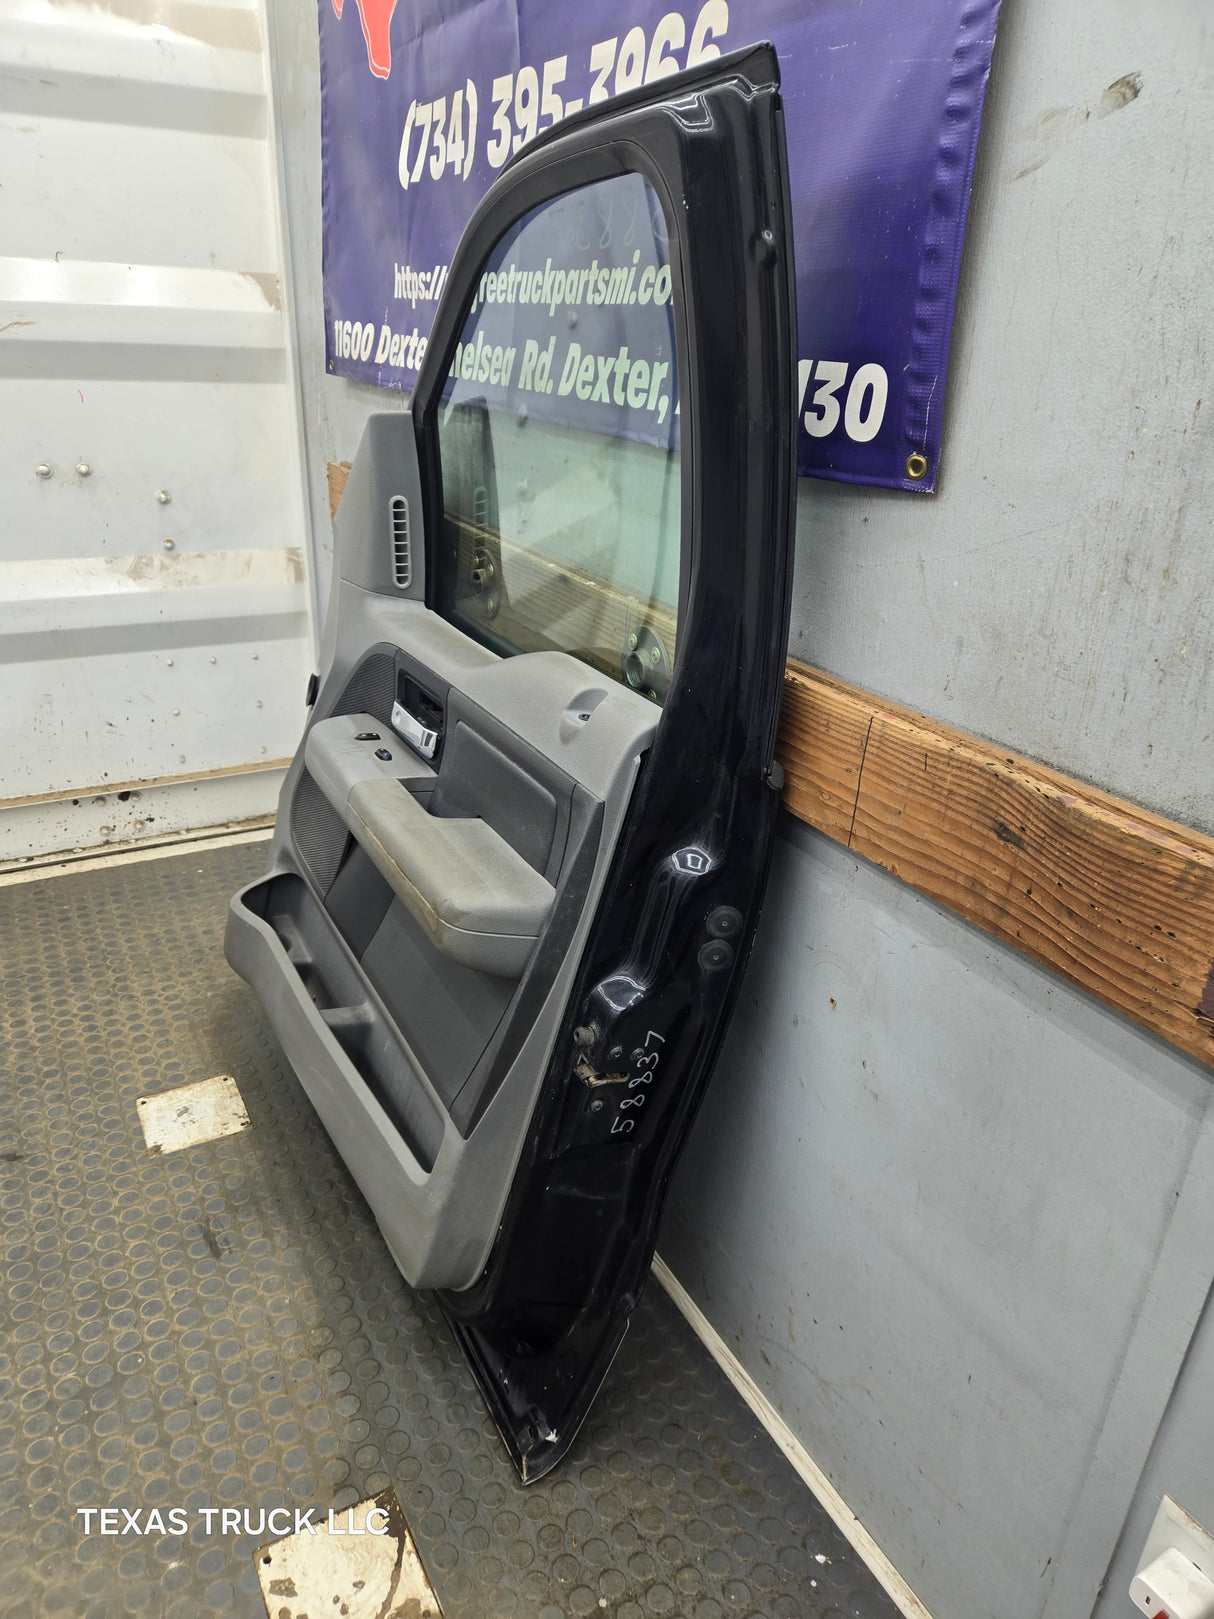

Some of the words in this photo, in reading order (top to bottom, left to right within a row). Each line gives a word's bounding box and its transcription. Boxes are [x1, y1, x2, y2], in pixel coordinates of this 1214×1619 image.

[398, 78, 478, 190] (734)
[487, 0, 729, 168] 395-3966
[334, 320, 375, 362] 11600
[518, 336, 557, 394] Rd.
[557, 342, 670, 424] Dexter,
[611, 1030, 665, 1133] 58837
